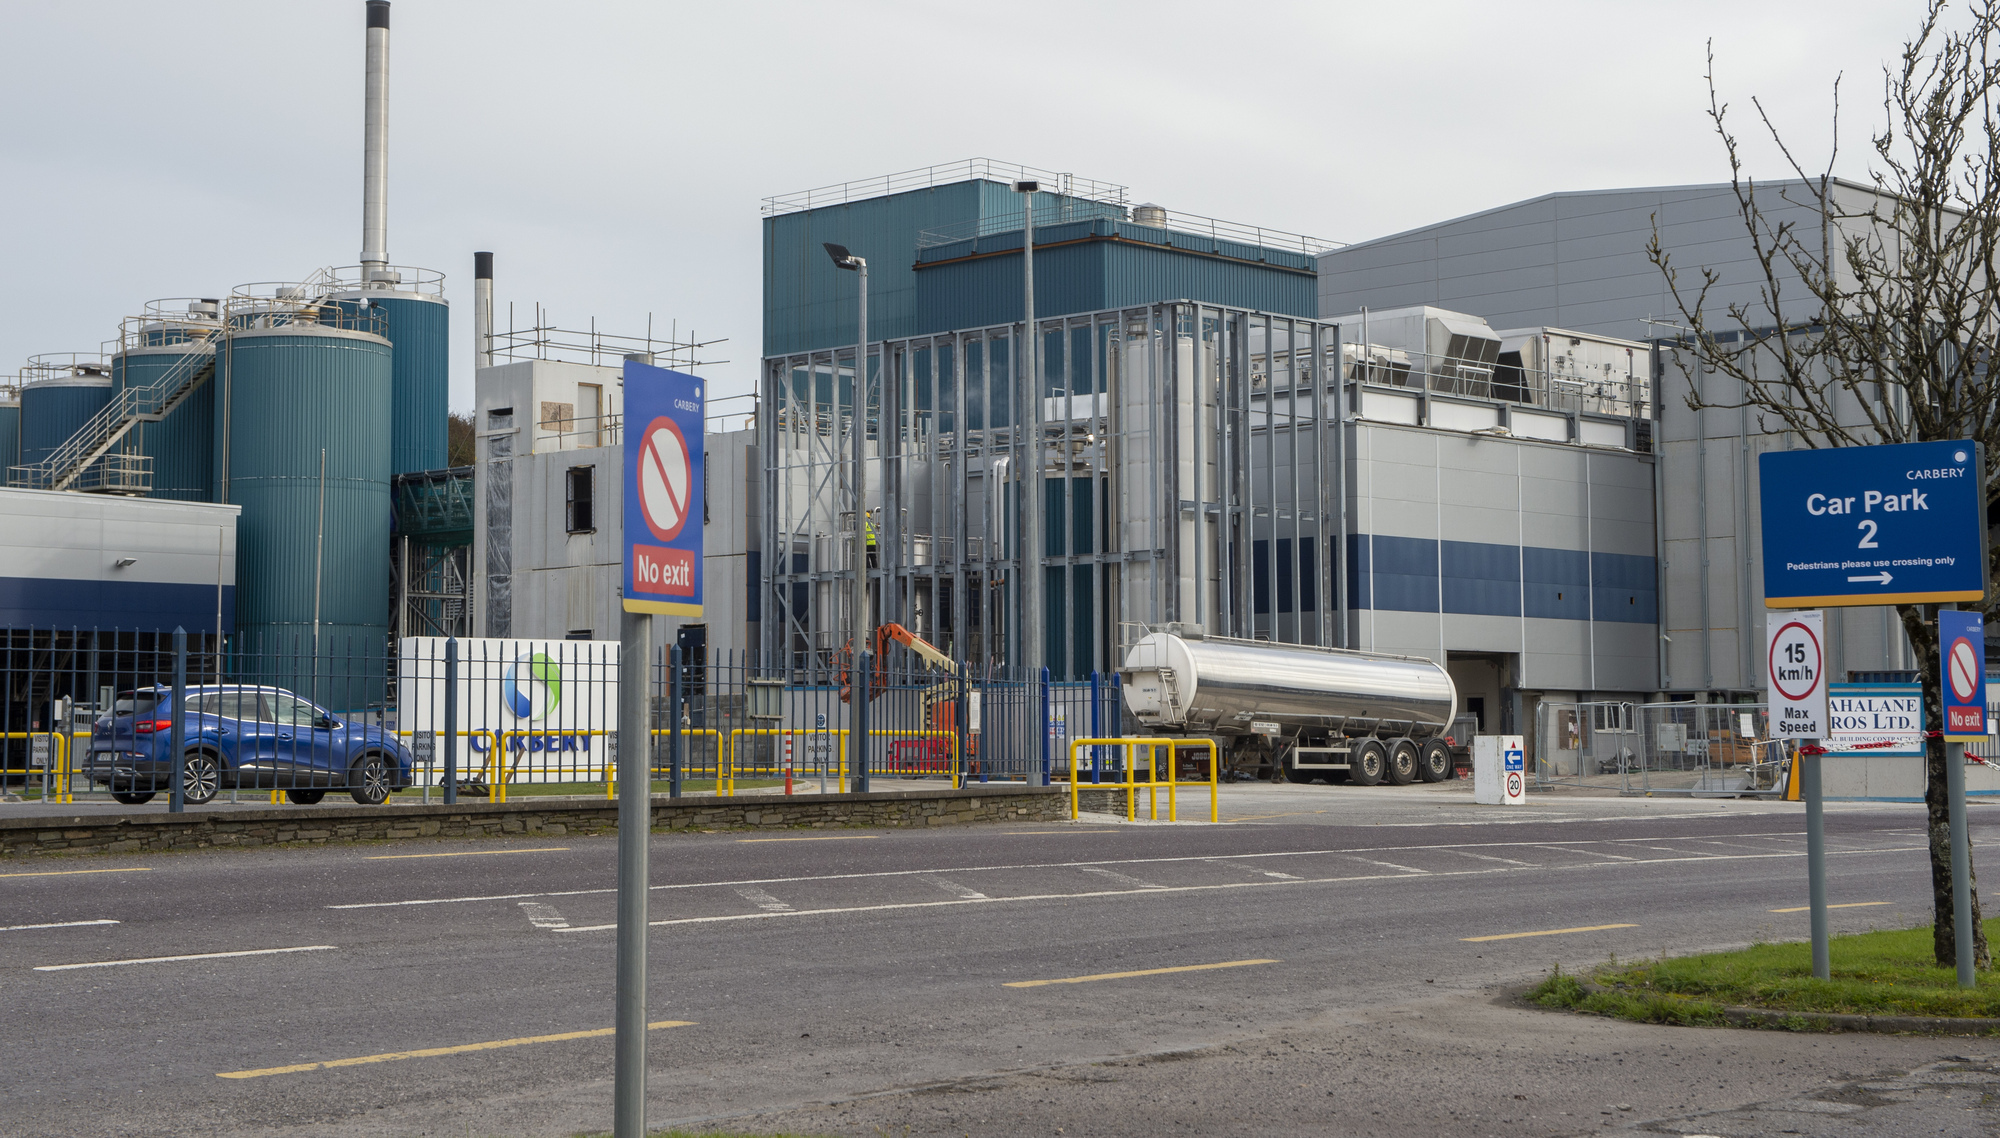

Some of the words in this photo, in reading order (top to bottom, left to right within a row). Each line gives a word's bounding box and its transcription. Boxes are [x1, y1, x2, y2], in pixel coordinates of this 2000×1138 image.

[674, 399, 700, 413] CARBERY
[1906, 467, 1966, 480] CARBERY
[1806, 493, 1856, 516] Car
[1864, 488, 1929, 513] Park
[1857, 519, 1879, 549] 2
[1786, 561, 1840, 571] Pedestrians
[1841, 559, 1871, 570] please
[1873, 559, 1890, 567] use
[1892, 556, 1933, 568] crossing
[1934, 556, 1955, 566] only
[638, 555, 659, 584] No
[663, 559, 690, 587] exit
[1784, 643, 1806, 663] 15
[1778, 665, 1813, 681] km/h
[1829, 699, 1917, 712] AHALANE
[1784, 707, 1809, 719] Max
[1951, 711, 1963, 726] No
[1964, 712, 1980, 727] exit
[1779, 721, 1816, 735] Speed
[1831, 716, 1867, 729] ROS
[34, 734, 49, 743] VISITO
[1510, 780, 1519, 790] 20
